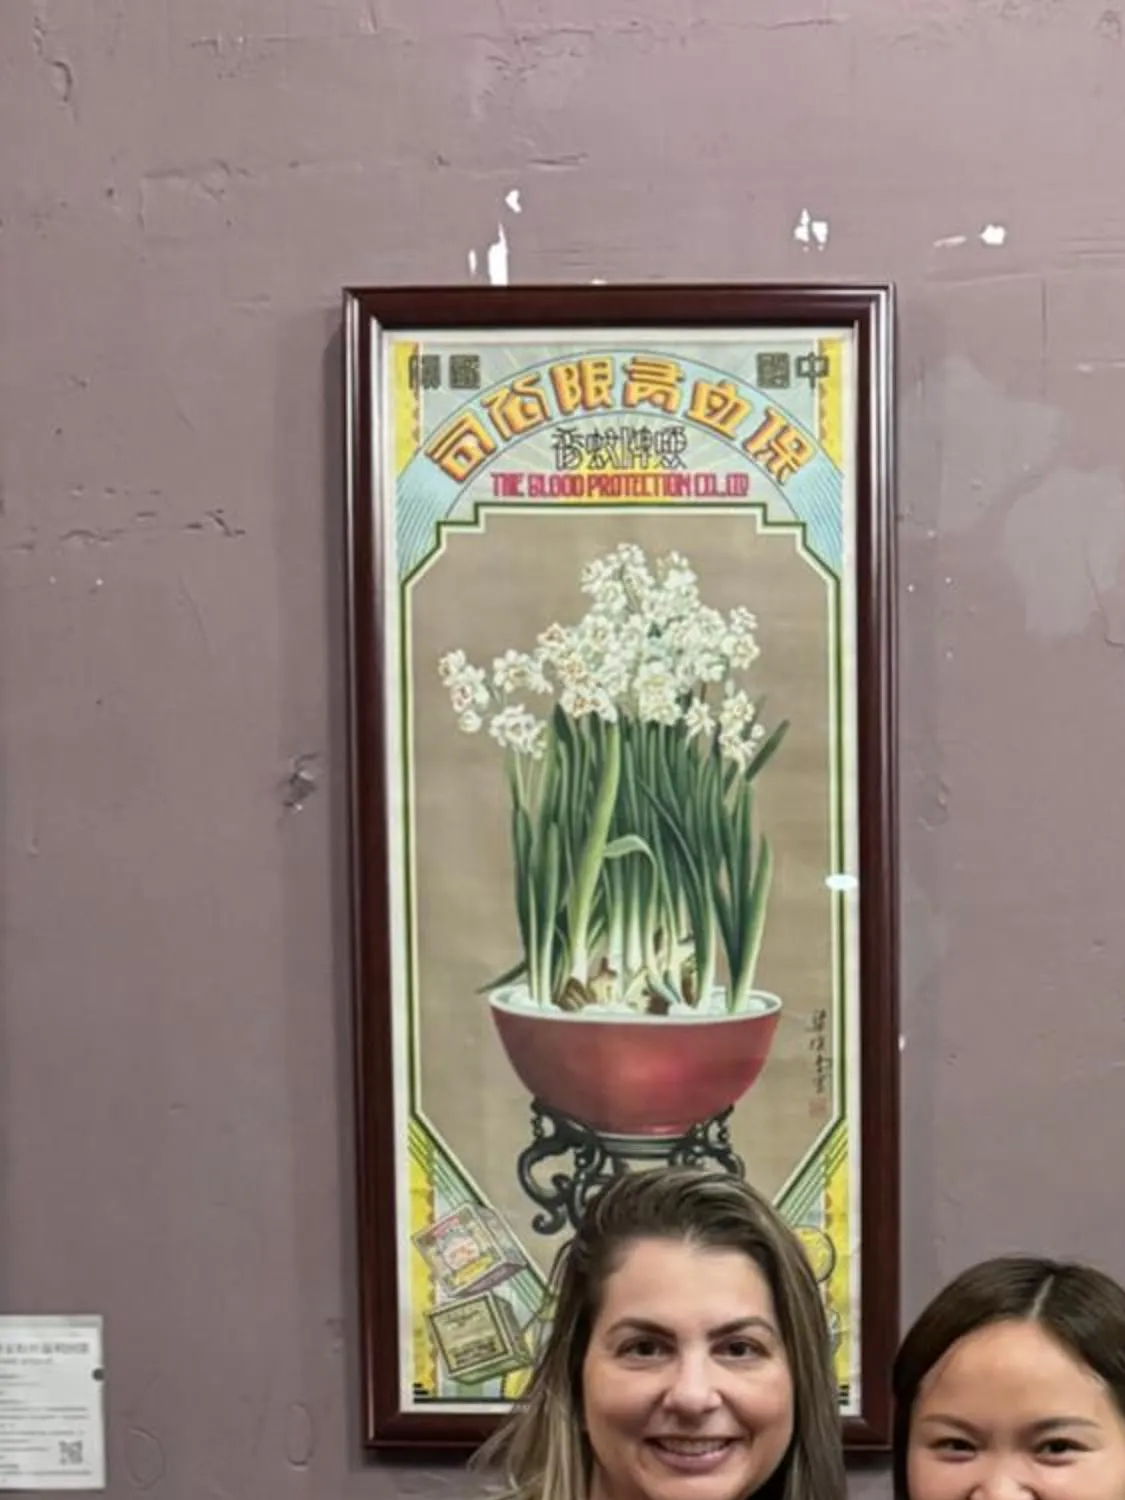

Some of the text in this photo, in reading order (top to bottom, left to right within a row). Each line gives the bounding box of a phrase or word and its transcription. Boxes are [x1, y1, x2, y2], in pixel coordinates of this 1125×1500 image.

[490, 472, 525, 497] THE
[528, 472, 584, 497] BLOOD
[586, 472, 690, 497] PROTECTION
